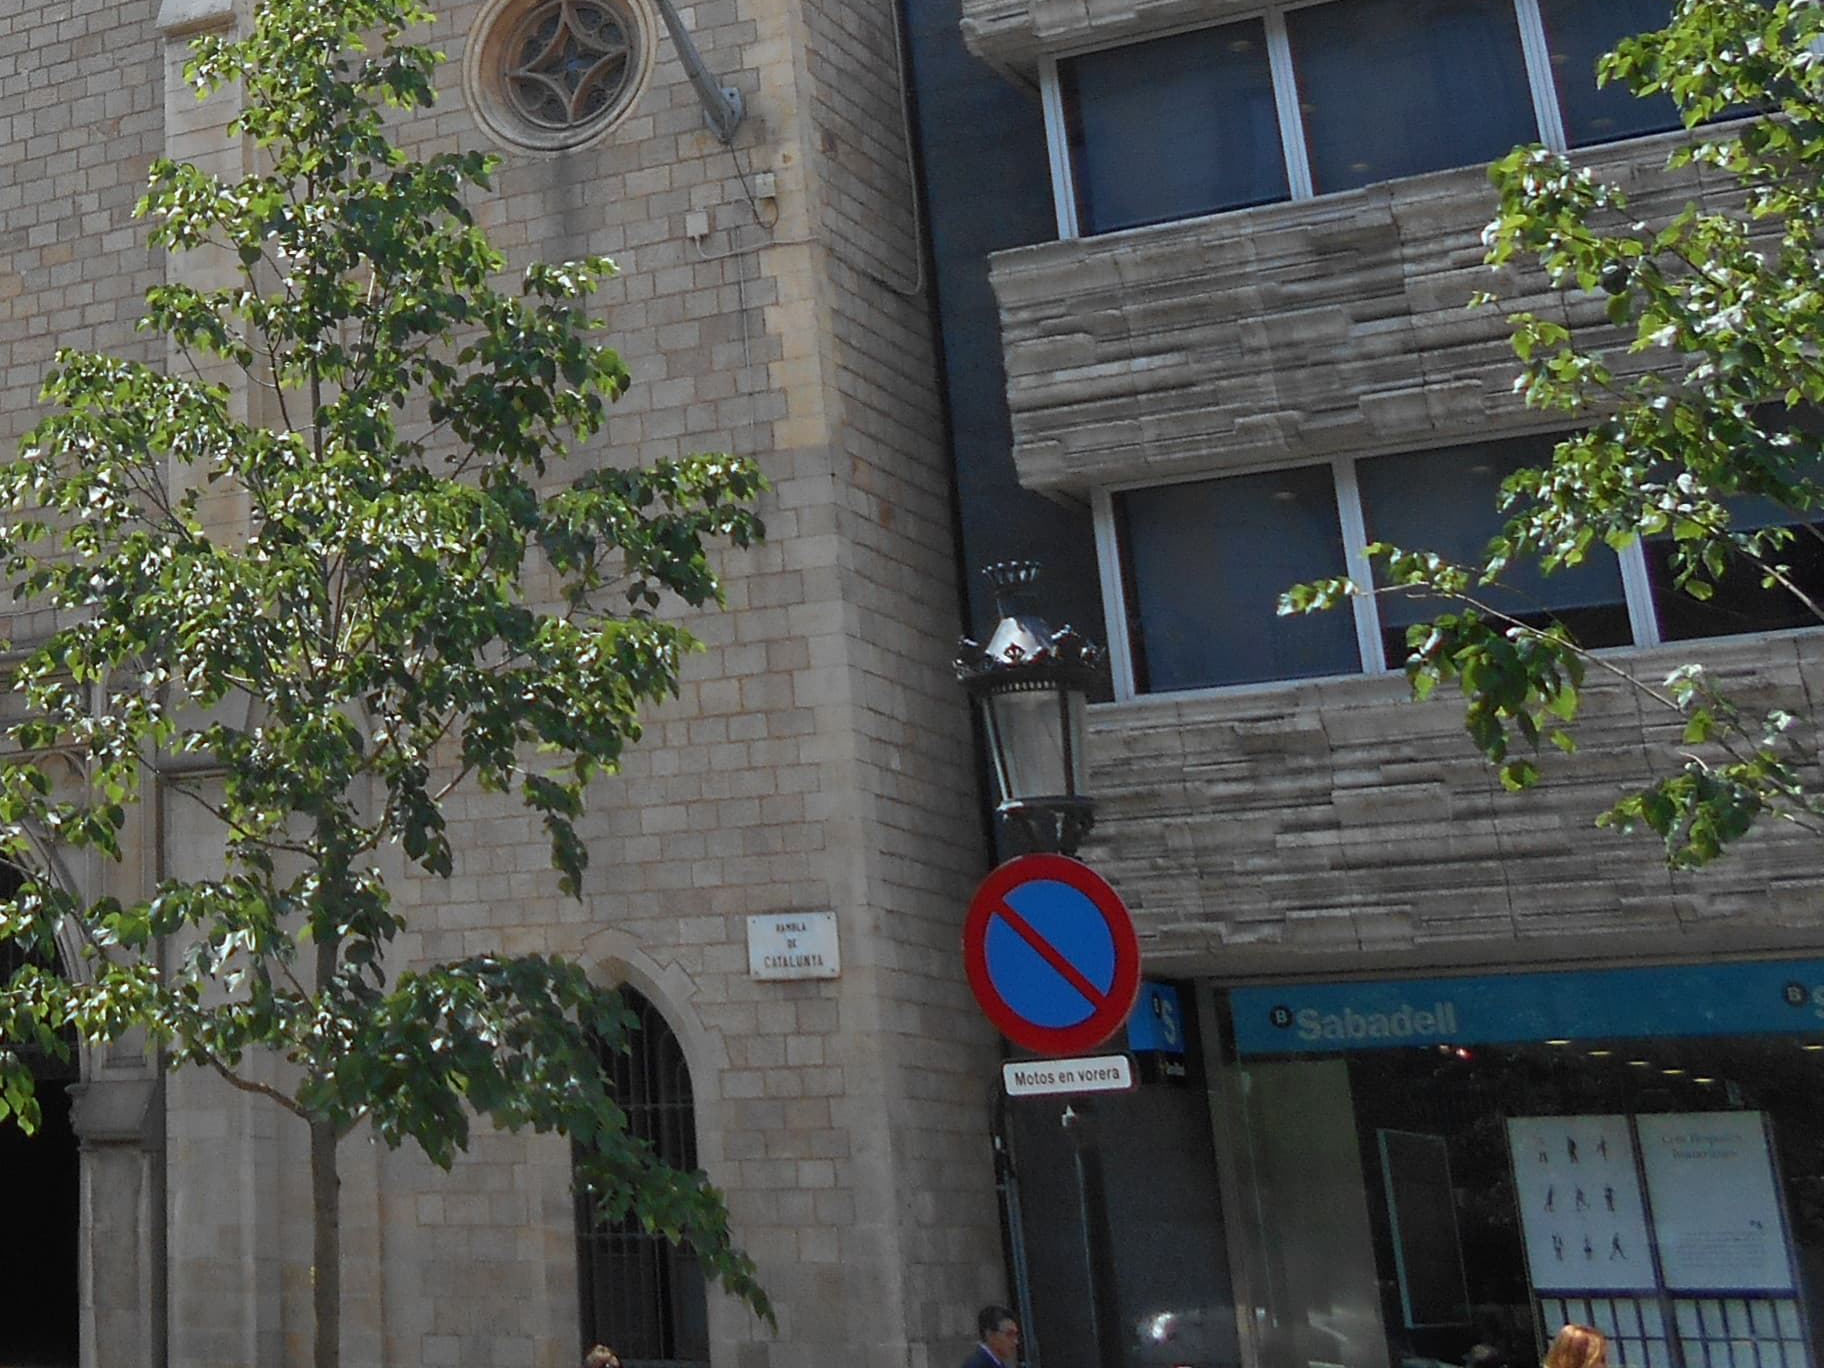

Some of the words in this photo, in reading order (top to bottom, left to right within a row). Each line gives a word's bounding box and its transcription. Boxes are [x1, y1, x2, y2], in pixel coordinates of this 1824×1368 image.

[764, 955, 824, 968] CATALUNYA
[1296, 1002, 1457, 1040] Sabadell
[1014, 1071, 1055, 1086] Motos
[1059, 1071, 1074, 1084] en
[1078, 1067, 1120, 1082] vorera
